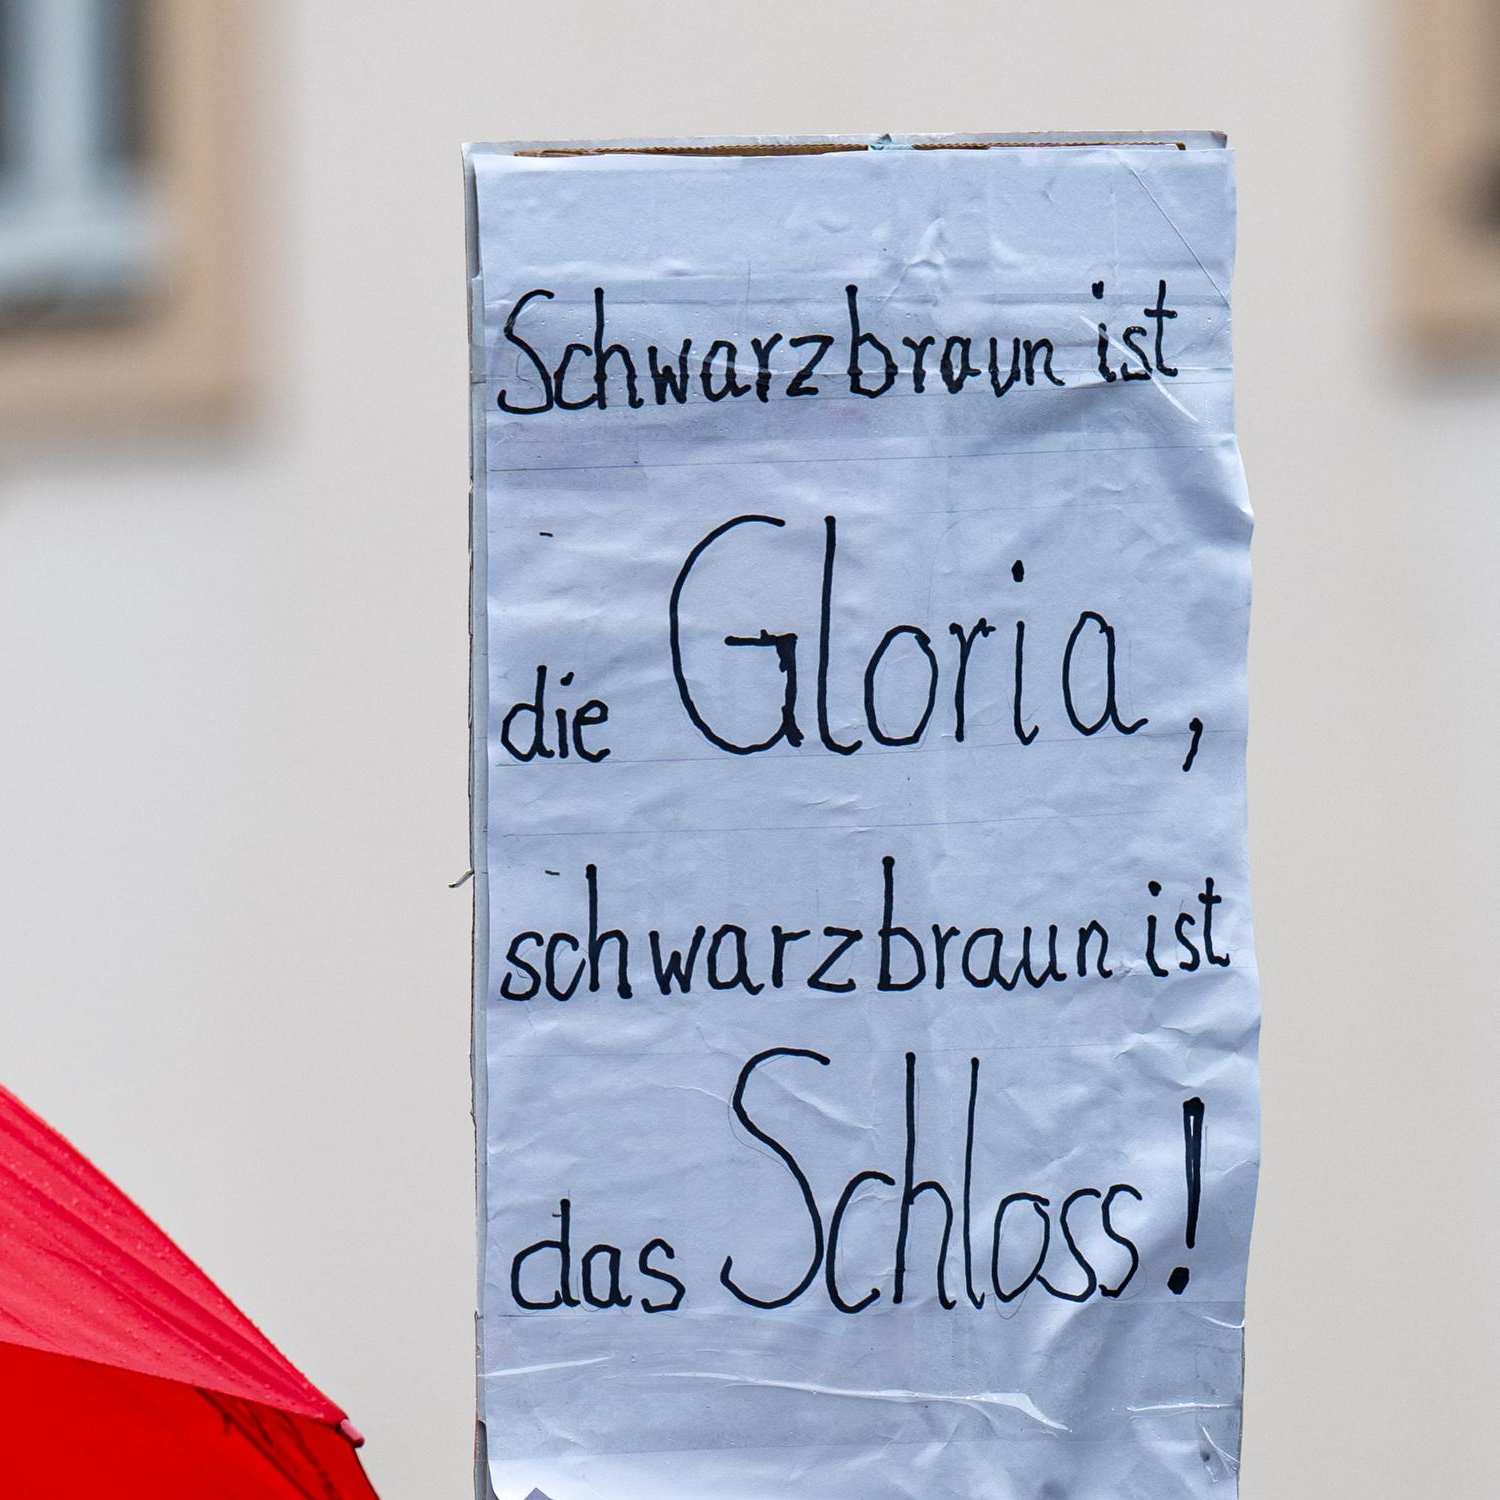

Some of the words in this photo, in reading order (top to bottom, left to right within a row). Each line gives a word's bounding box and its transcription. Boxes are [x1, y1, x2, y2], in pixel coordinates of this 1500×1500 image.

[497, 285, 1065, 414] Schwarzbraun
[1092, 280, 1177, 383] ist
[501, 665, 610, 763] die
[670, 515, 1203, 772] Gloria,
[501, 856, 1112, 1001] schwarzbraun
[1146, 878, 1230, 977] ist
[511, 1199, 685, 1313] das
[721, 1048, 1204, 1314] Schloss!
